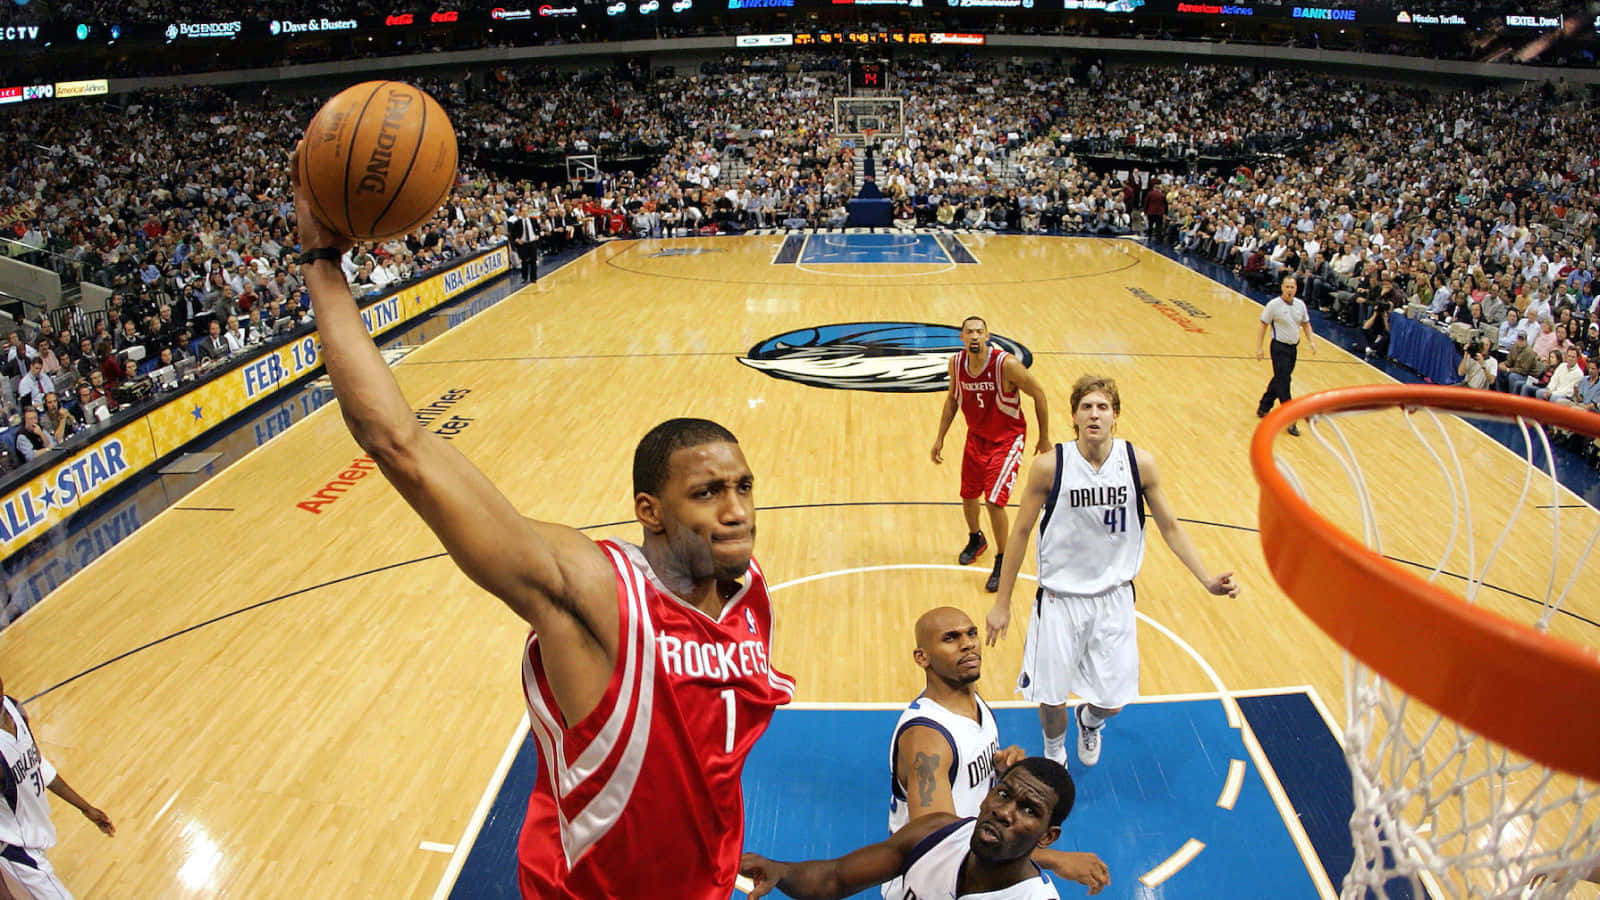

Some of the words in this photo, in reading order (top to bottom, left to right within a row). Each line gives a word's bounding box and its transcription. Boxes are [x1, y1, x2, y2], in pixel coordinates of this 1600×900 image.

[282, 21, 307, 33] Dave
[356, 90, 414, 195] SPALDING
[444, 272, 465, 295] NBA
[374, 296, 400, 327] TNT
[243, 352, 289, 398] FEB.
[976, 393, 985, 408] 5
[296, 453, 375, 514] Ameri
[1070, 486, 1128, 508] DALLAS
[1103, 507, 1127, 533] 41
[656, 630, 768, 682] ROCKETS
[720, 689, 737, 754] 1
[31, 768, 45, 798] 31
